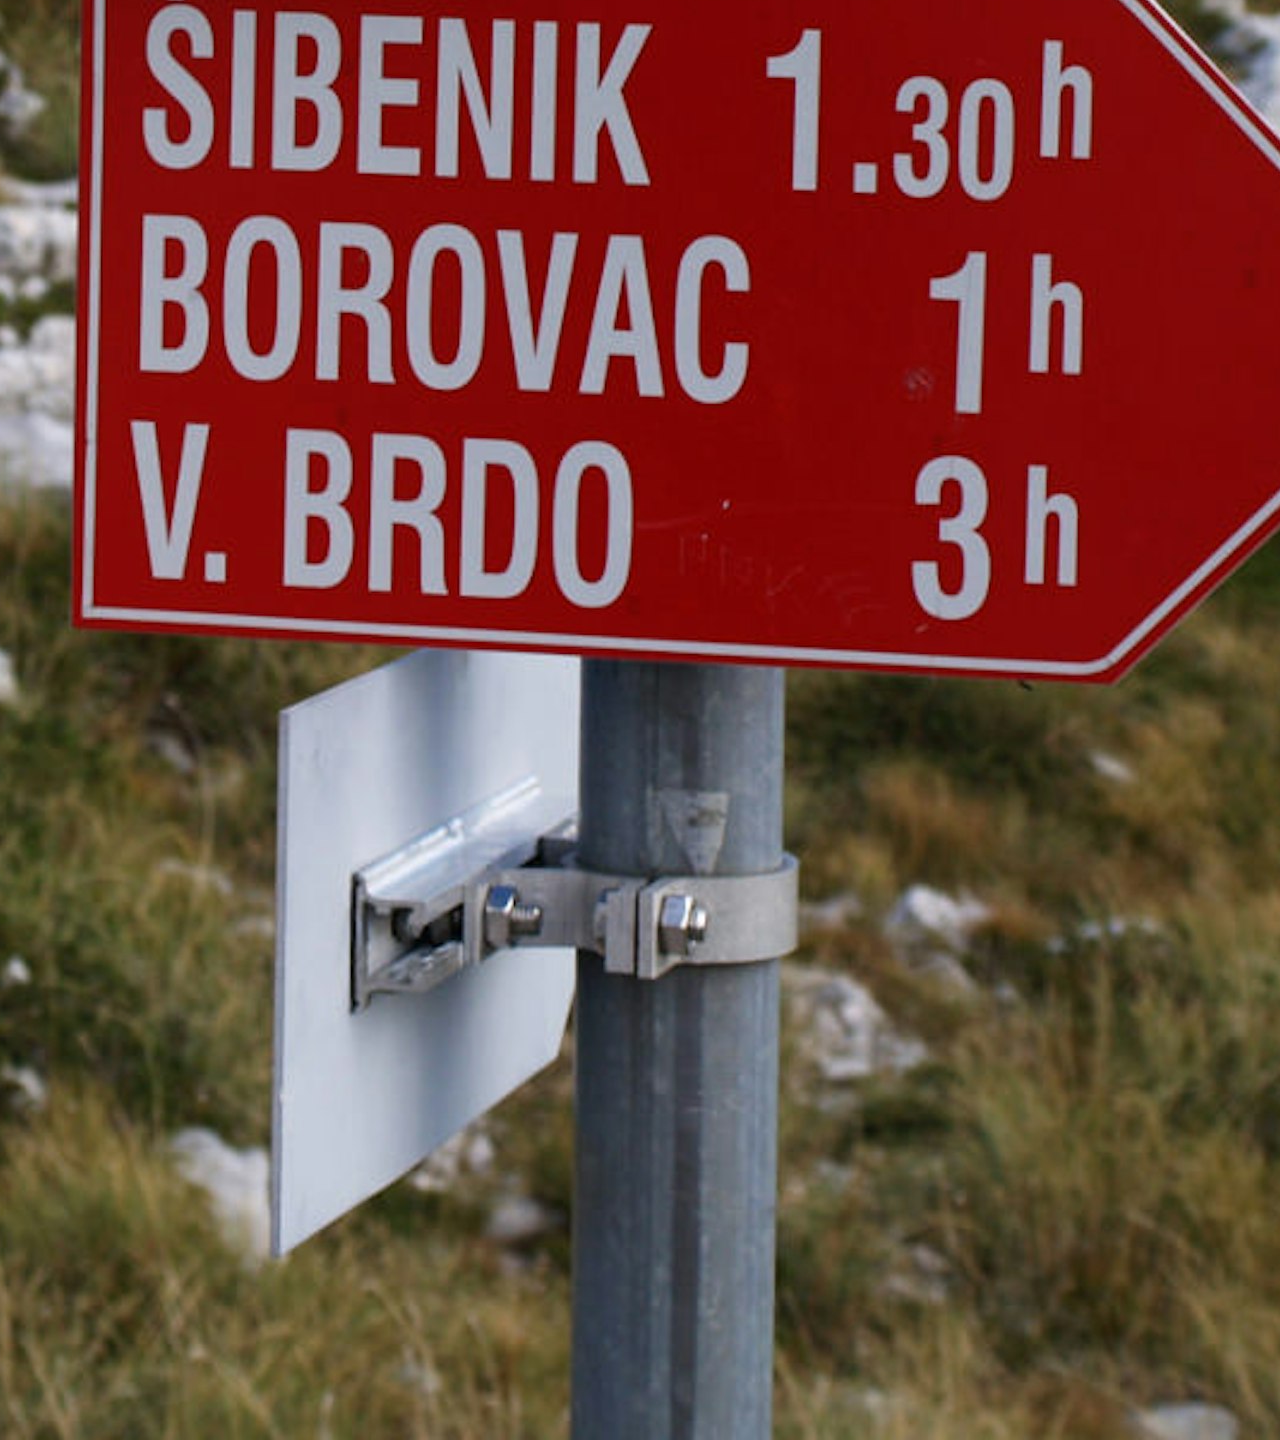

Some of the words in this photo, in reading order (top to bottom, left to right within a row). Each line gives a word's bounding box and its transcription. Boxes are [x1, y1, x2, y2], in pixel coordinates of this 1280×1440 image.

[766, 28, 1015, 201] 1.30
[139, 214, 750, 405] BOROVAC
[929, 251, 987, 415] 1
[131, 420, 227, 583] V.
[283, 428, 634, 609] BRDO
[911, 455, 991, 621] 3
